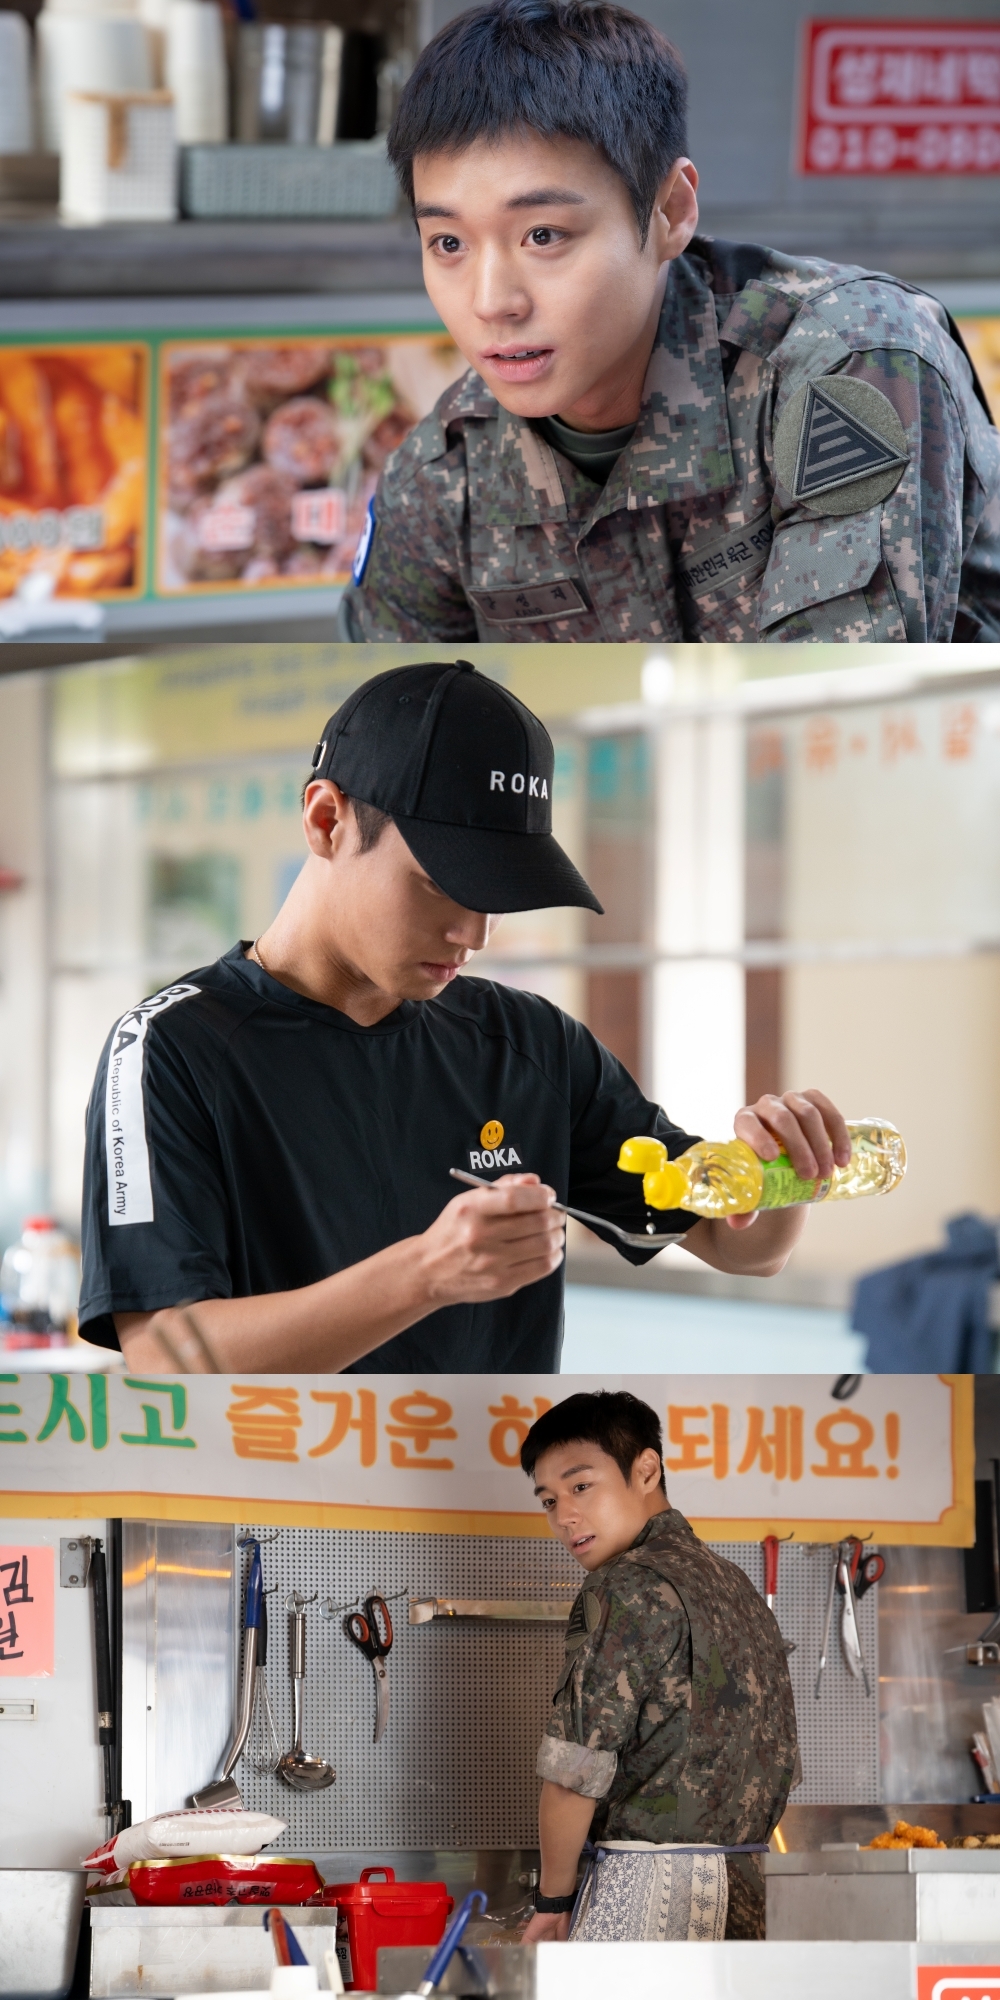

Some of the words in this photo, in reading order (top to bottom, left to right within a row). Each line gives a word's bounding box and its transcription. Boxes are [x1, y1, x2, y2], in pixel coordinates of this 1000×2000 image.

[489, 770, 549, 800] ROKA
[111, 1057, 123, 1115] Republic
[111, 1118, 123, 1132] of
[112, 1136, 125, 1177] Korea
[469, 1147, 522, 1170] ROKA
[113, 1181, 128, 1215] Army
[225, 1384, 458, 1471] 즐거운
[664, 1402, 902, 1481] 되세요!
